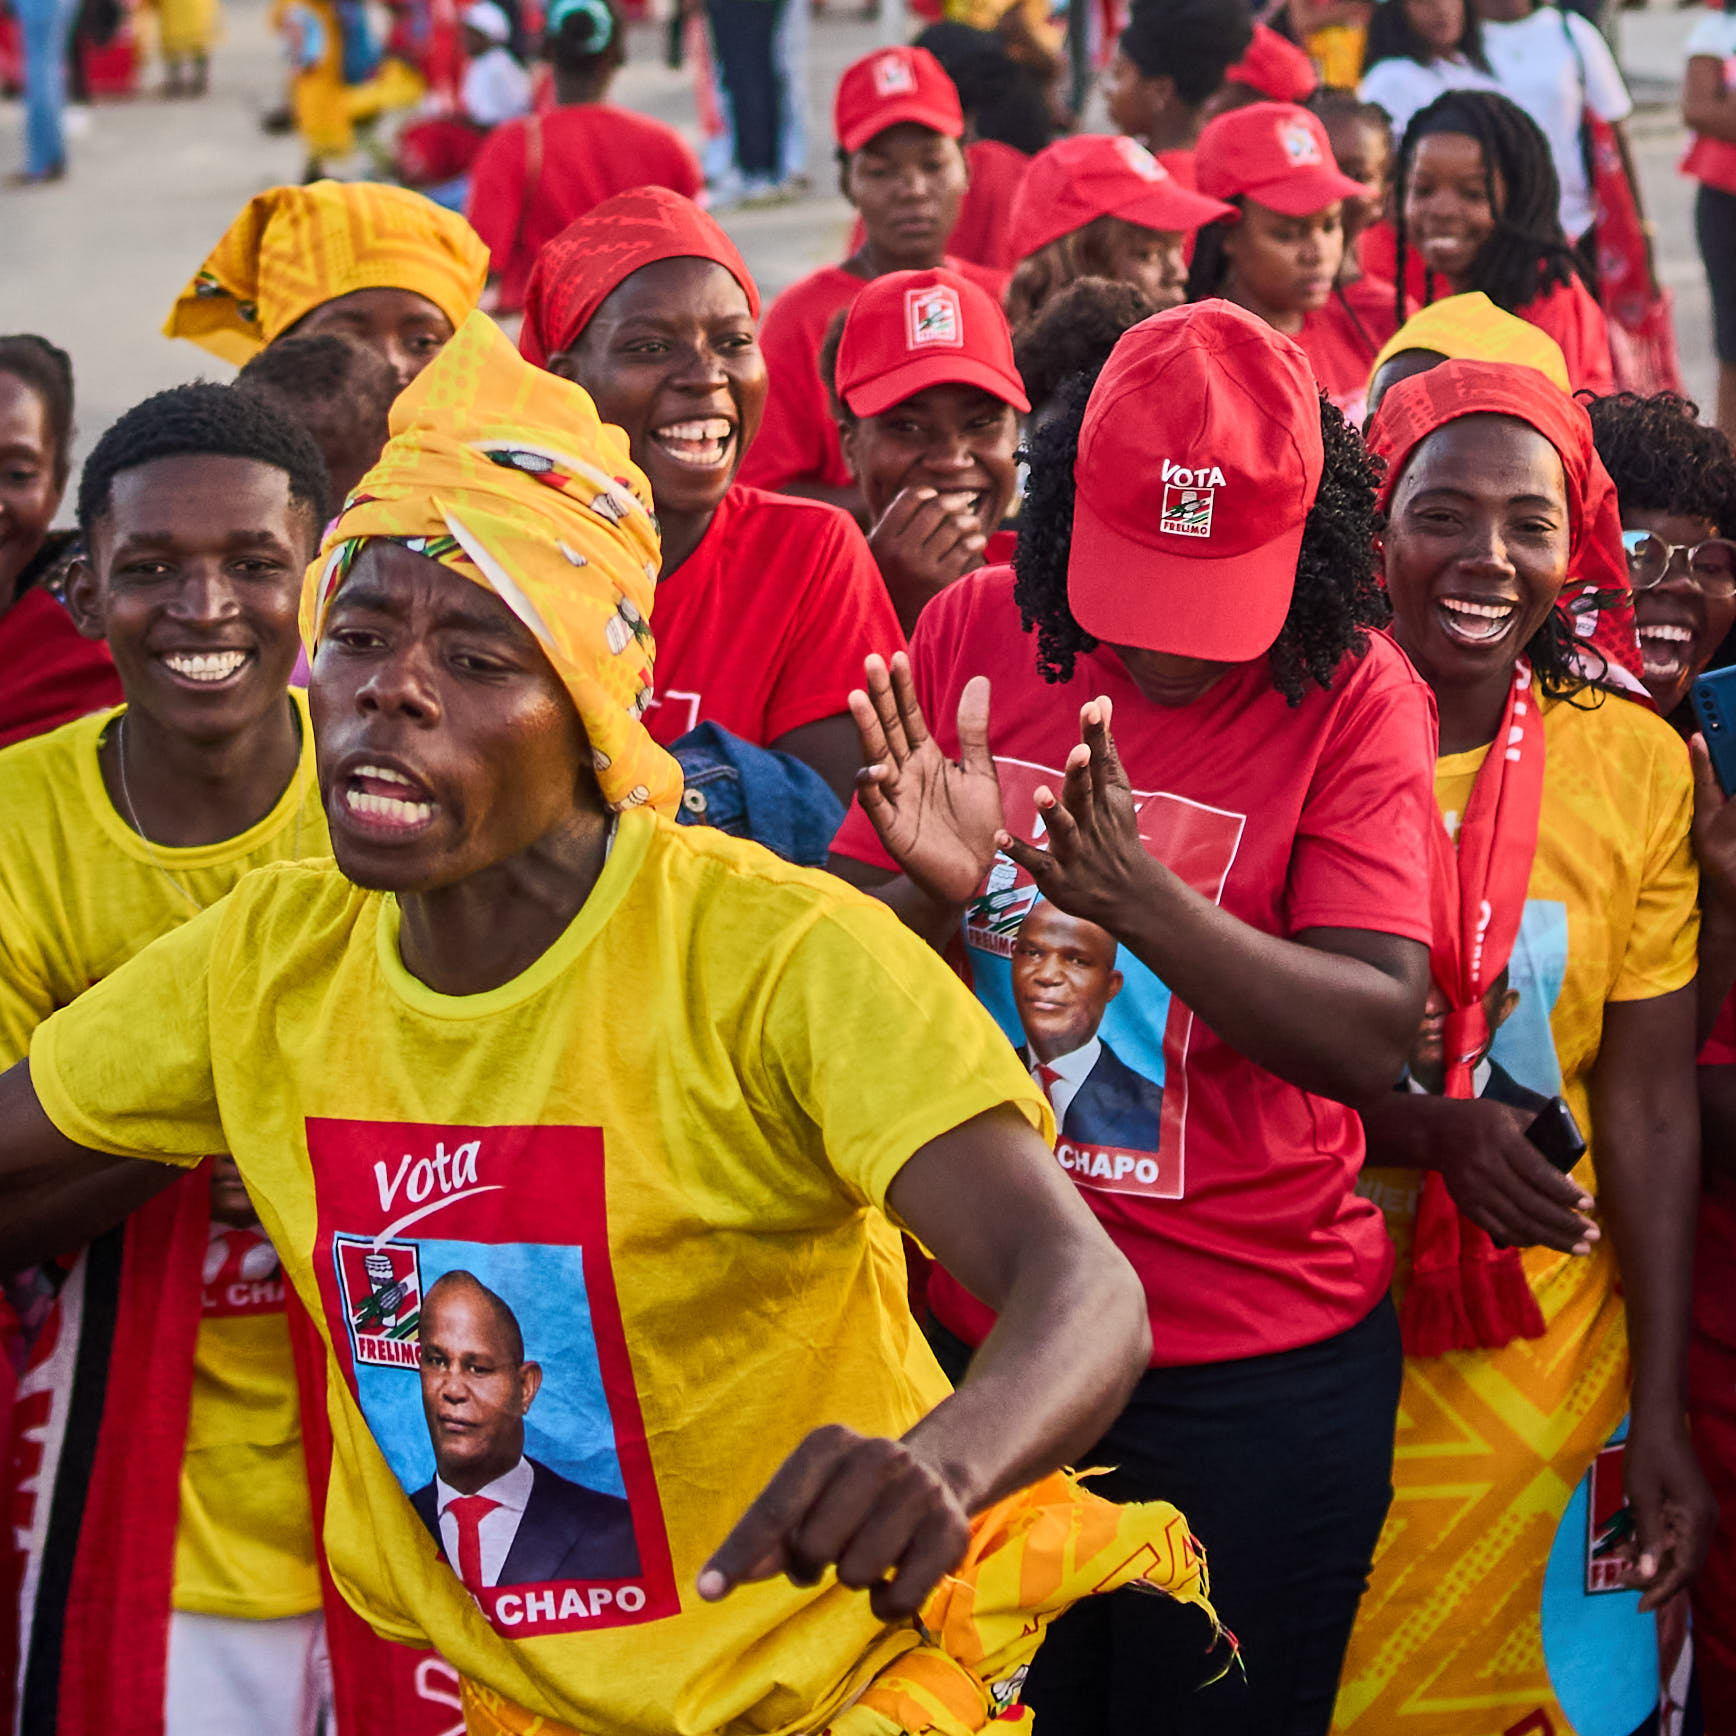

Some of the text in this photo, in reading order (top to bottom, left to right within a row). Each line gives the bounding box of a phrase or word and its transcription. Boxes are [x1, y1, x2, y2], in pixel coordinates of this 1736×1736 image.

[1161, 458, 1226, 488] VOTA
[1163, 521, 1208, 535] FRELIMO
[374, 1141, 481, 1212] Vota
[1057, 1144, 1159, 1184] CHAPO
[495, 1585, 647, 1626] CHAPO
